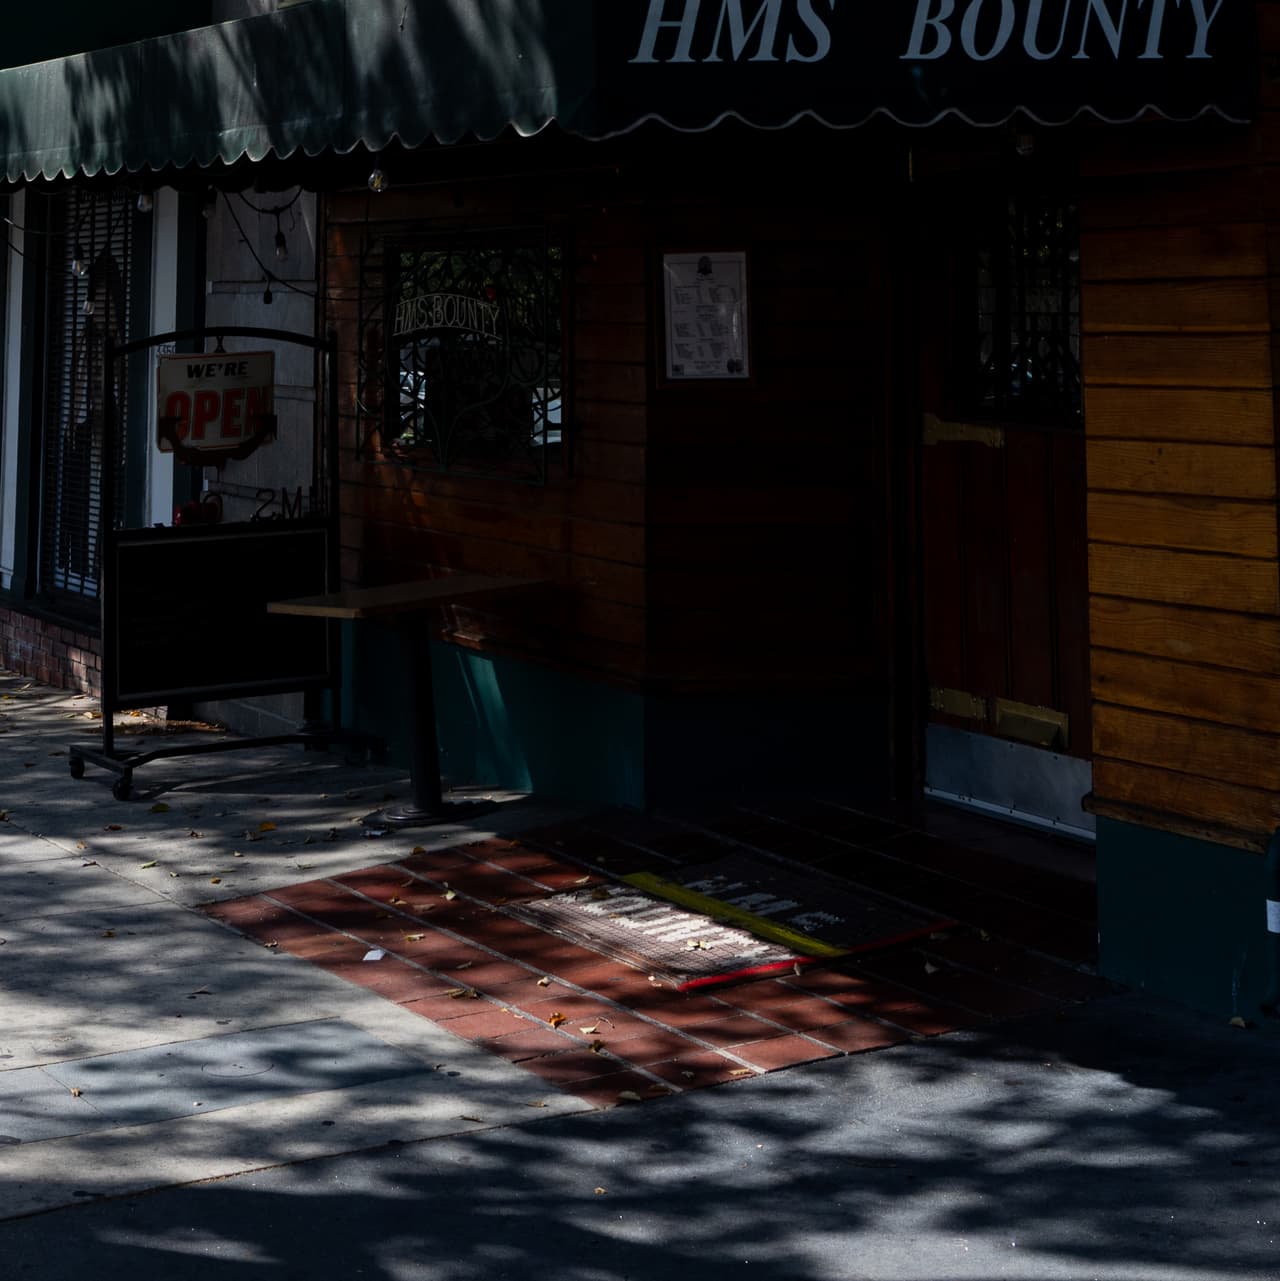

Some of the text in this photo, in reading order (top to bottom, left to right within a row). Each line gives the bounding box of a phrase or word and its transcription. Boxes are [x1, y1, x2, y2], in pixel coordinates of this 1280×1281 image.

[393, 295, 501, 336] HMS BOUNTY
[187, 361, 249, 378] WE'RE
[166, 387, 270, 441] OPEN
